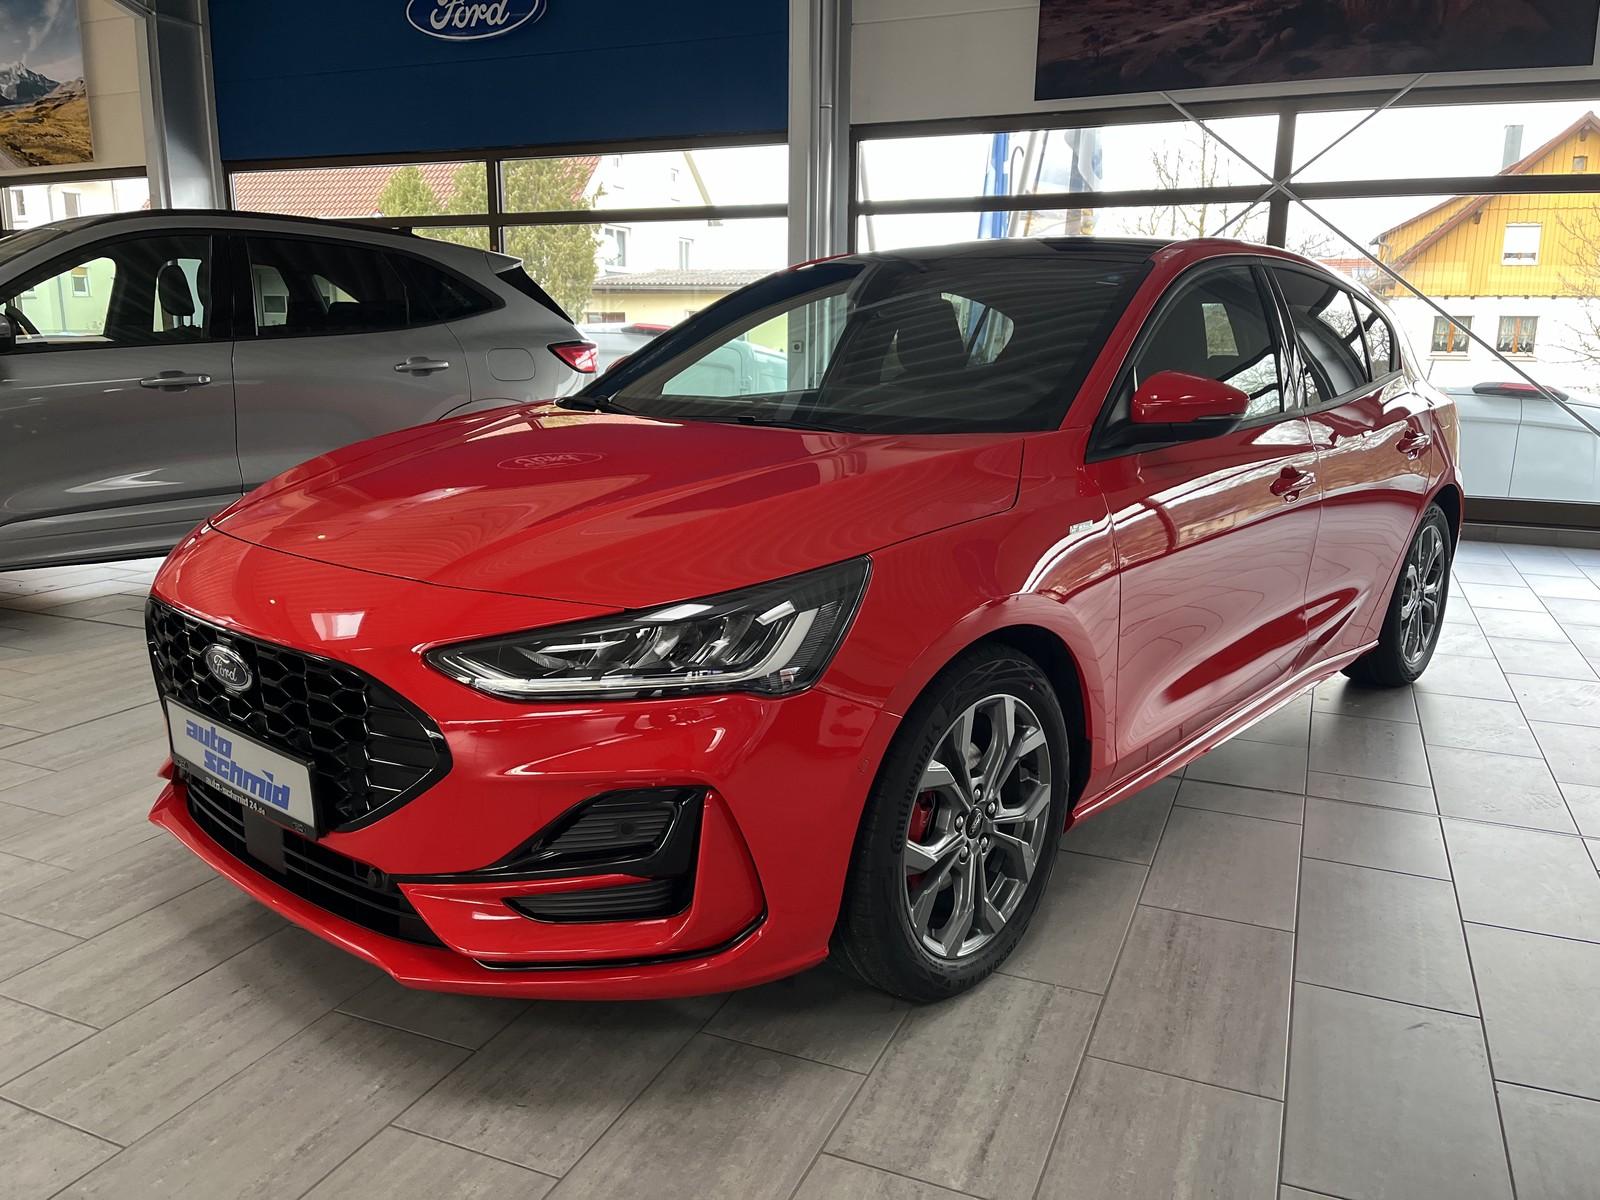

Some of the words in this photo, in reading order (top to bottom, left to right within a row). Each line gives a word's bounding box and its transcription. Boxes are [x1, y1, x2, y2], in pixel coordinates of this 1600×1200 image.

[430, 0, 510, 30] Ford
[212, 654, 238, 682] Ford
[186, 719, 232, 760] auto
[204, 749, 291, 810] schmid
